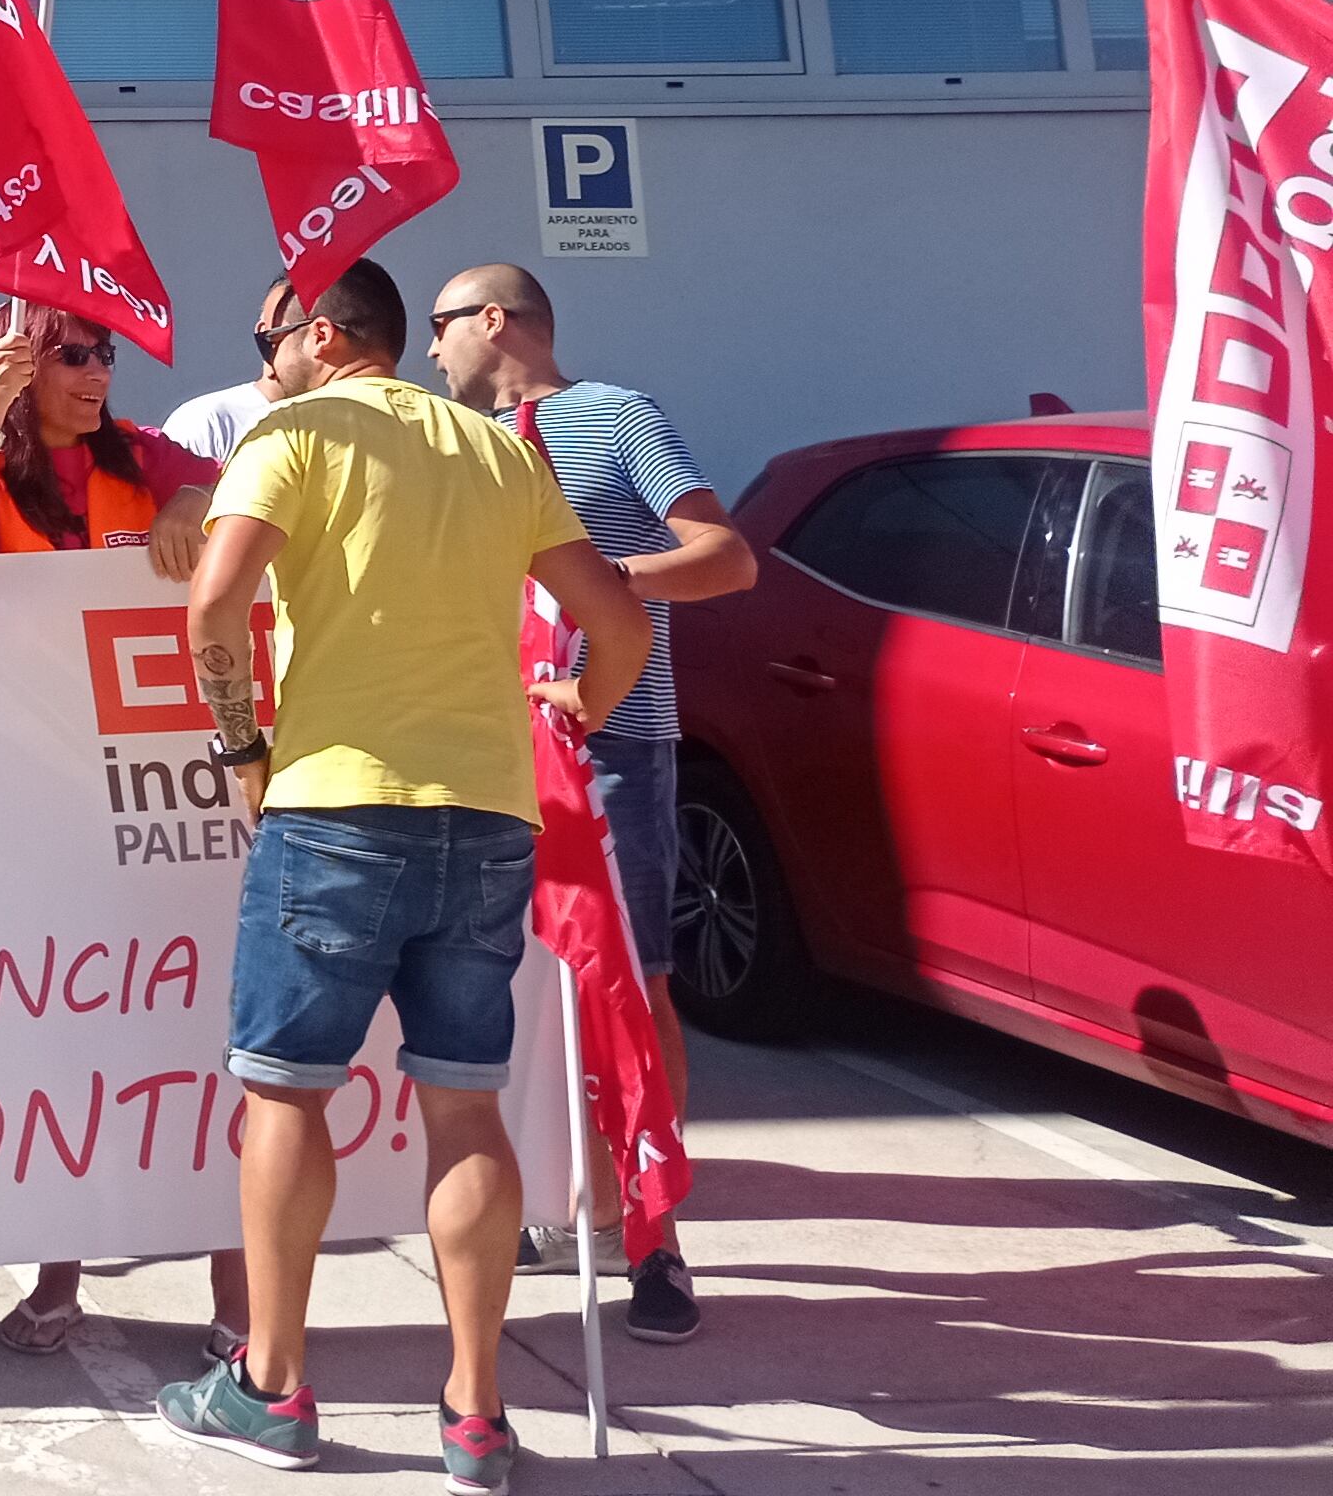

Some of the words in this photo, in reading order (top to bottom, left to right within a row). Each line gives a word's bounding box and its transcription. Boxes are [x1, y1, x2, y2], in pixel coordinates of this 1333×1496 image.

[561, 133, 616, 200] P
[547, 215, 639, 225] APARCAMIENTO
[578, 228, 610, 239] PARA
[559, 241, 631, 252] EMPLEADOS
[114, 818, 254, 866] PALEN
